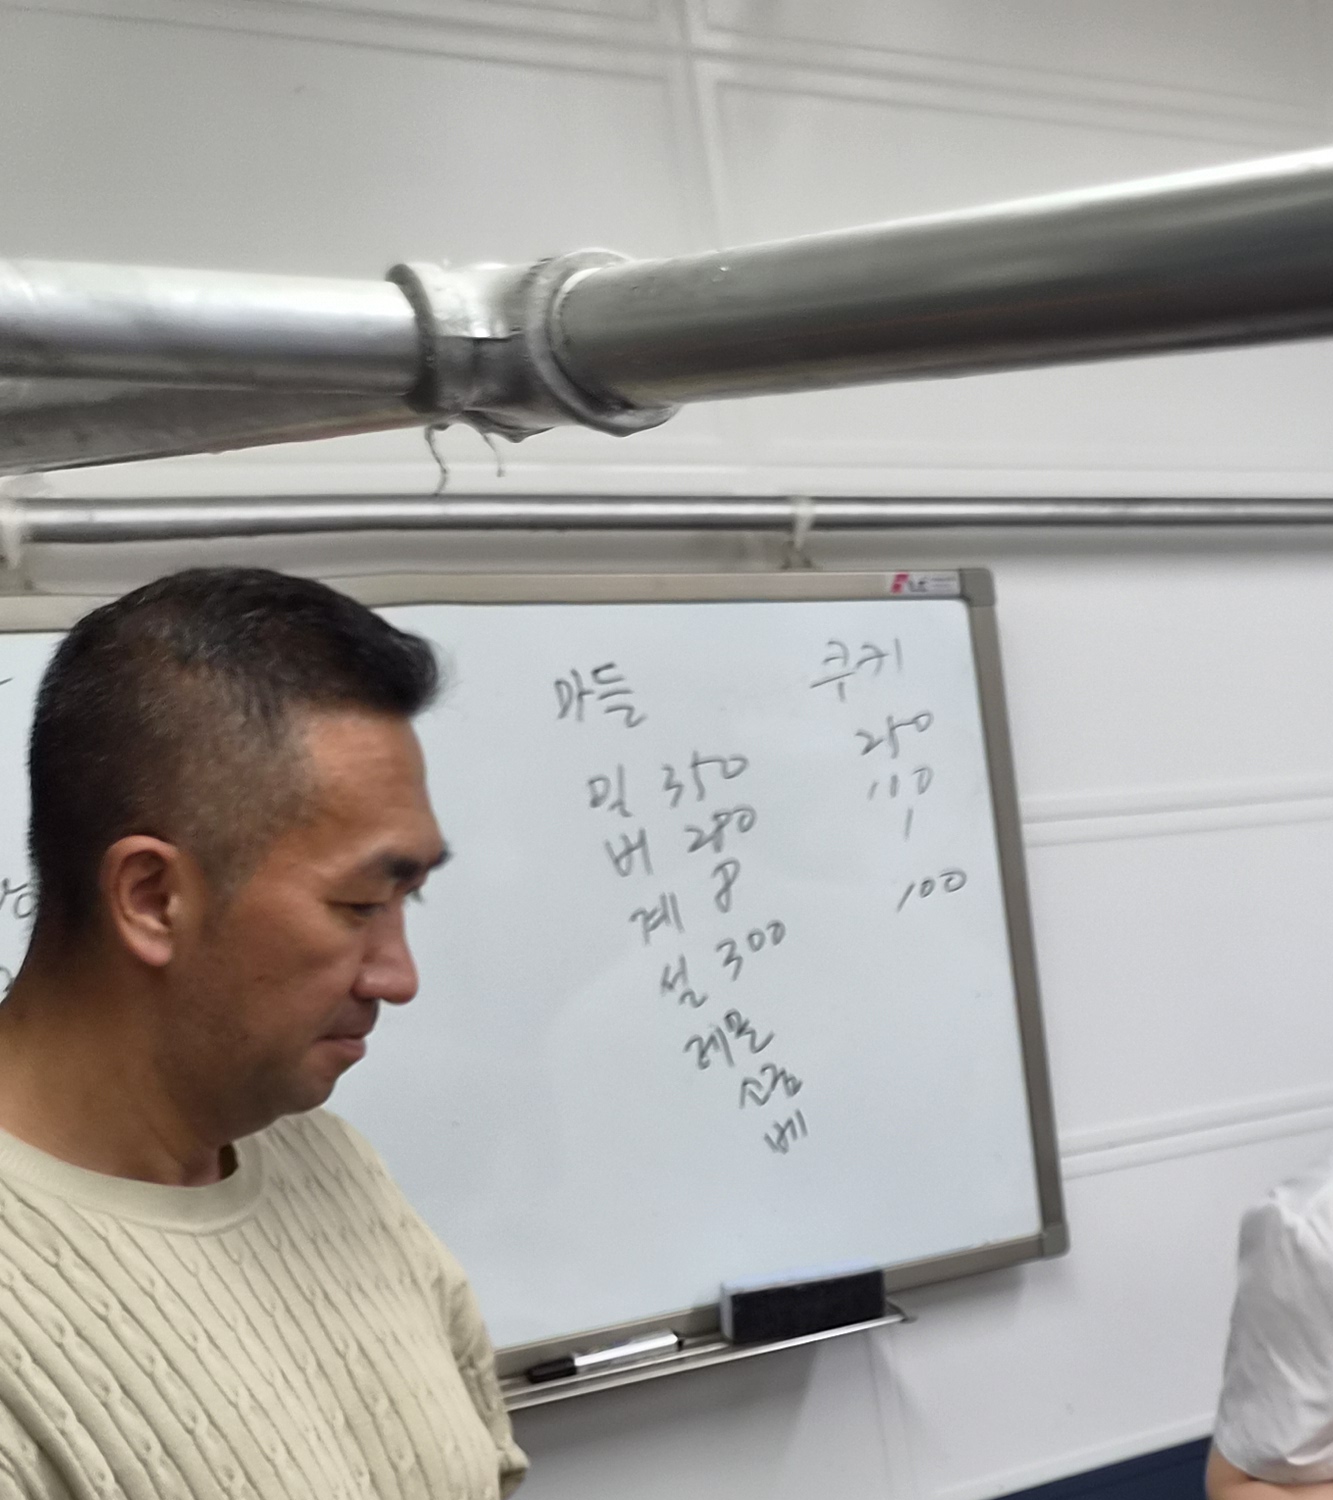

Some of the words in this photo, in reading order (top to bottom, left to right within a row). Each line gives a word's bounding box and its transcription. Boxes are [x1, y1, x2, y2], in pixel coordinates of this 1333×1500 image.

[554, 661, 648, 729] 마들
[809, 637, 904, 702] 쿠키
[855, 710, 934, 760] 250
[587, 762, 634, 818] 밀
[661, 750, 749, 809] 350
[604, 826, 651, 878] 버
[683, 803, 757, 854] 280
[896, 868, 968, 914] 100
[715, 919, 787, 983] 300
